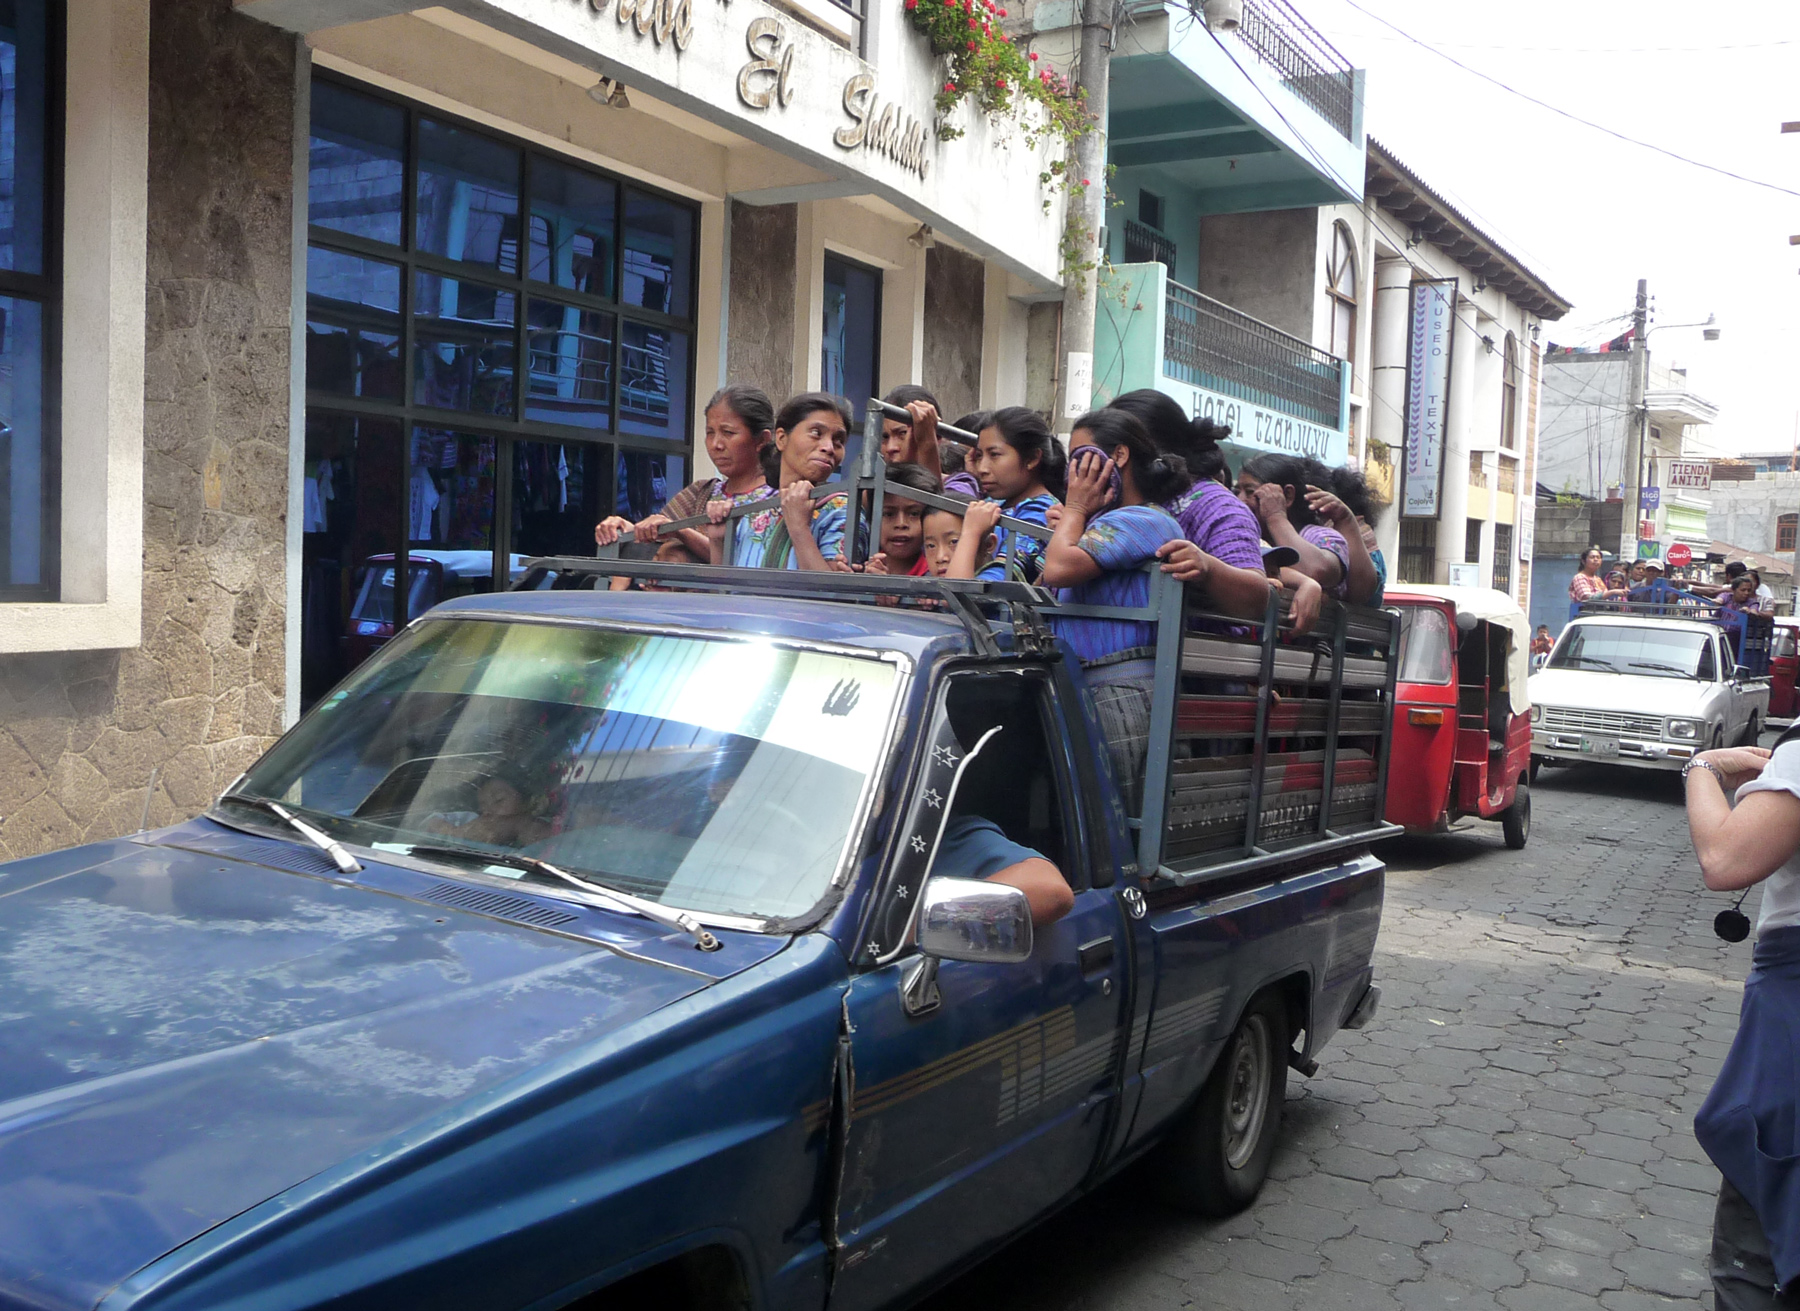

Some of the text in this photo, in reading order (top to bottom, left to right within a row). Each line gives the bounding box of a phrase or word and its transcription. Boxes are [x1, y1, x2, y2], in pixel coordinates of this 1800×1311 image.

[736, 17, 794, 109] El
[1432, 293, 1445, 356] MUSEO
[1671, 463, 1710, 476] TIENDA
[1671, 475, 1708, 487] ANITA
[1667, 550, 1687, 559] Claro
